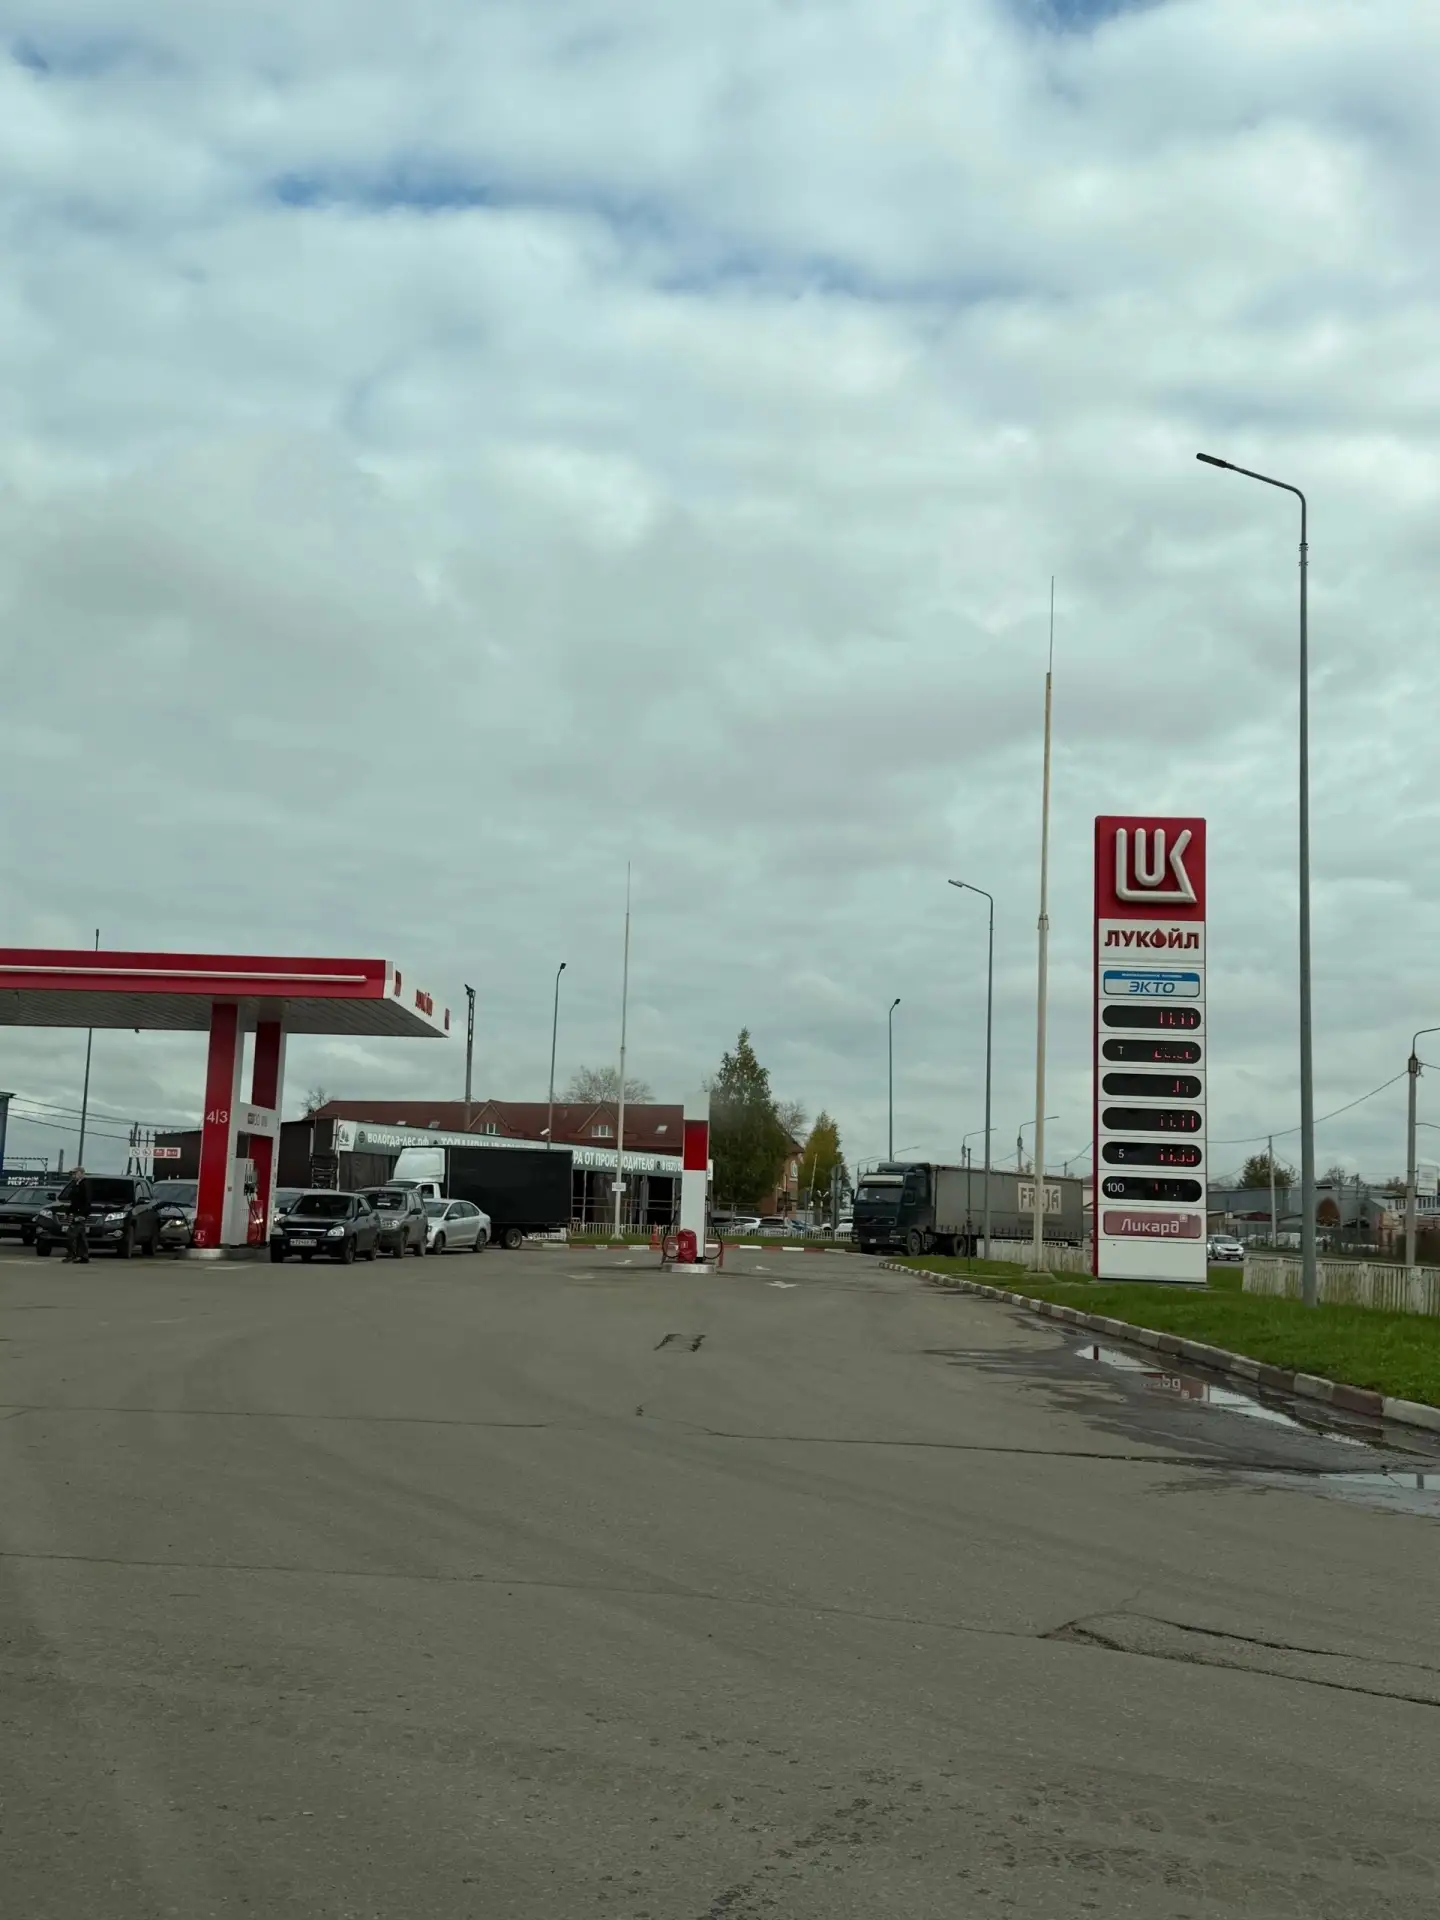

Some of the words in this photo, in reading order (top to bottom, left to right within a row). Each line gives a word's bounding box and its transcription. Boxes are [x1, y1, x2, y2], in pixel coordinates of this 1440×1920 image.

[1104, 927, 1200, 950] ЛУКОЙЛ
[1128, 981, 1175, 994] ЭКТО
[584, 1151, 595, 1166] ОТ
[595, 1152, 655, 1172] ПРОИЗОДИТЕЛЯ
[1106, 1182, 1125, 1193] 100
[1020, 1186, 1060, 1212] FRJA
[1120, 1217, 1180, 1235] Ликард
